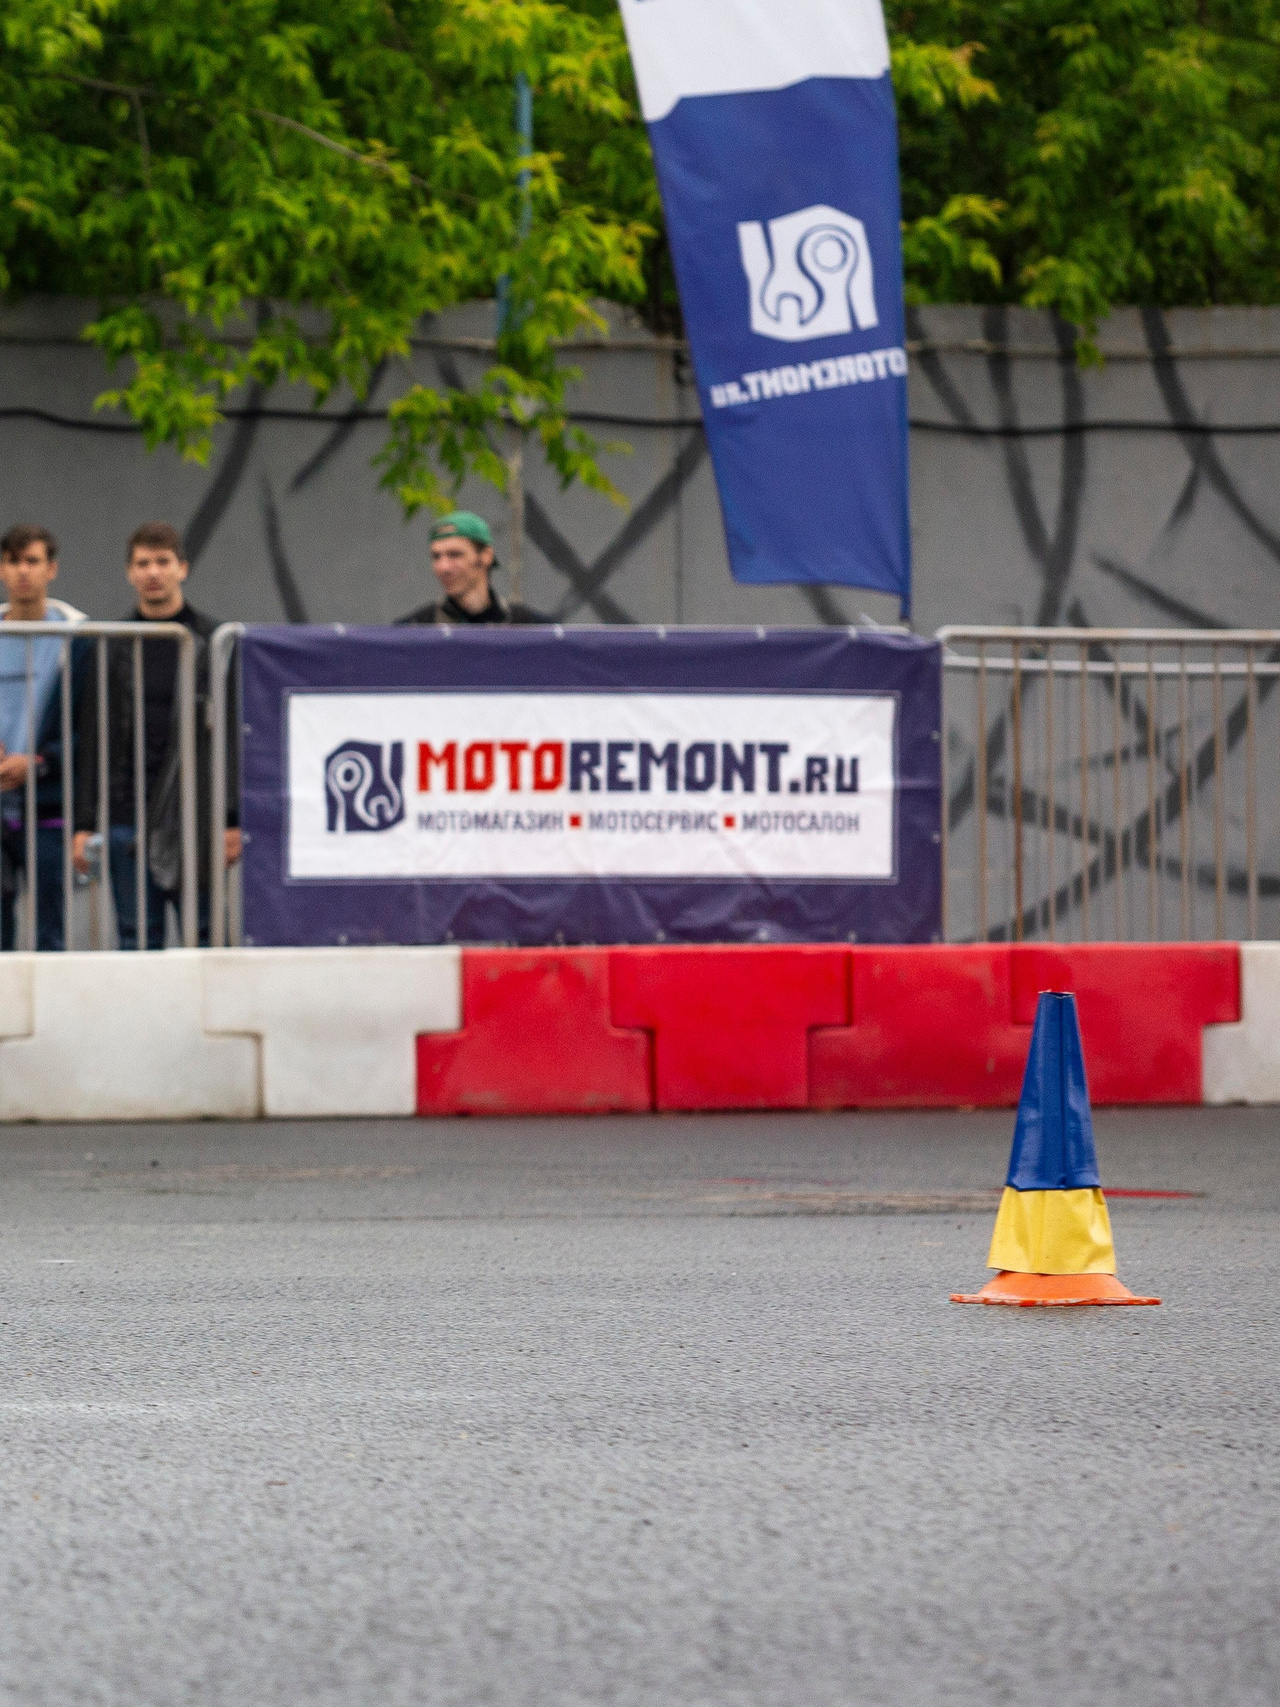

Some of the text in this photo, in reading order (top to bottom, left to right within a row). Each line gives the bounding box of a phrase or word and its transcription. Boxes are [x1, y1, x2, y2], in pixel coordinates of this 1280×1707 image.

[418, 741, 860, 793] MOTOREMONT.RU
[418, 810, 860, 833] МОТОМАГАЗИН МОТОСЕРВИС МОТОСАЛОН
